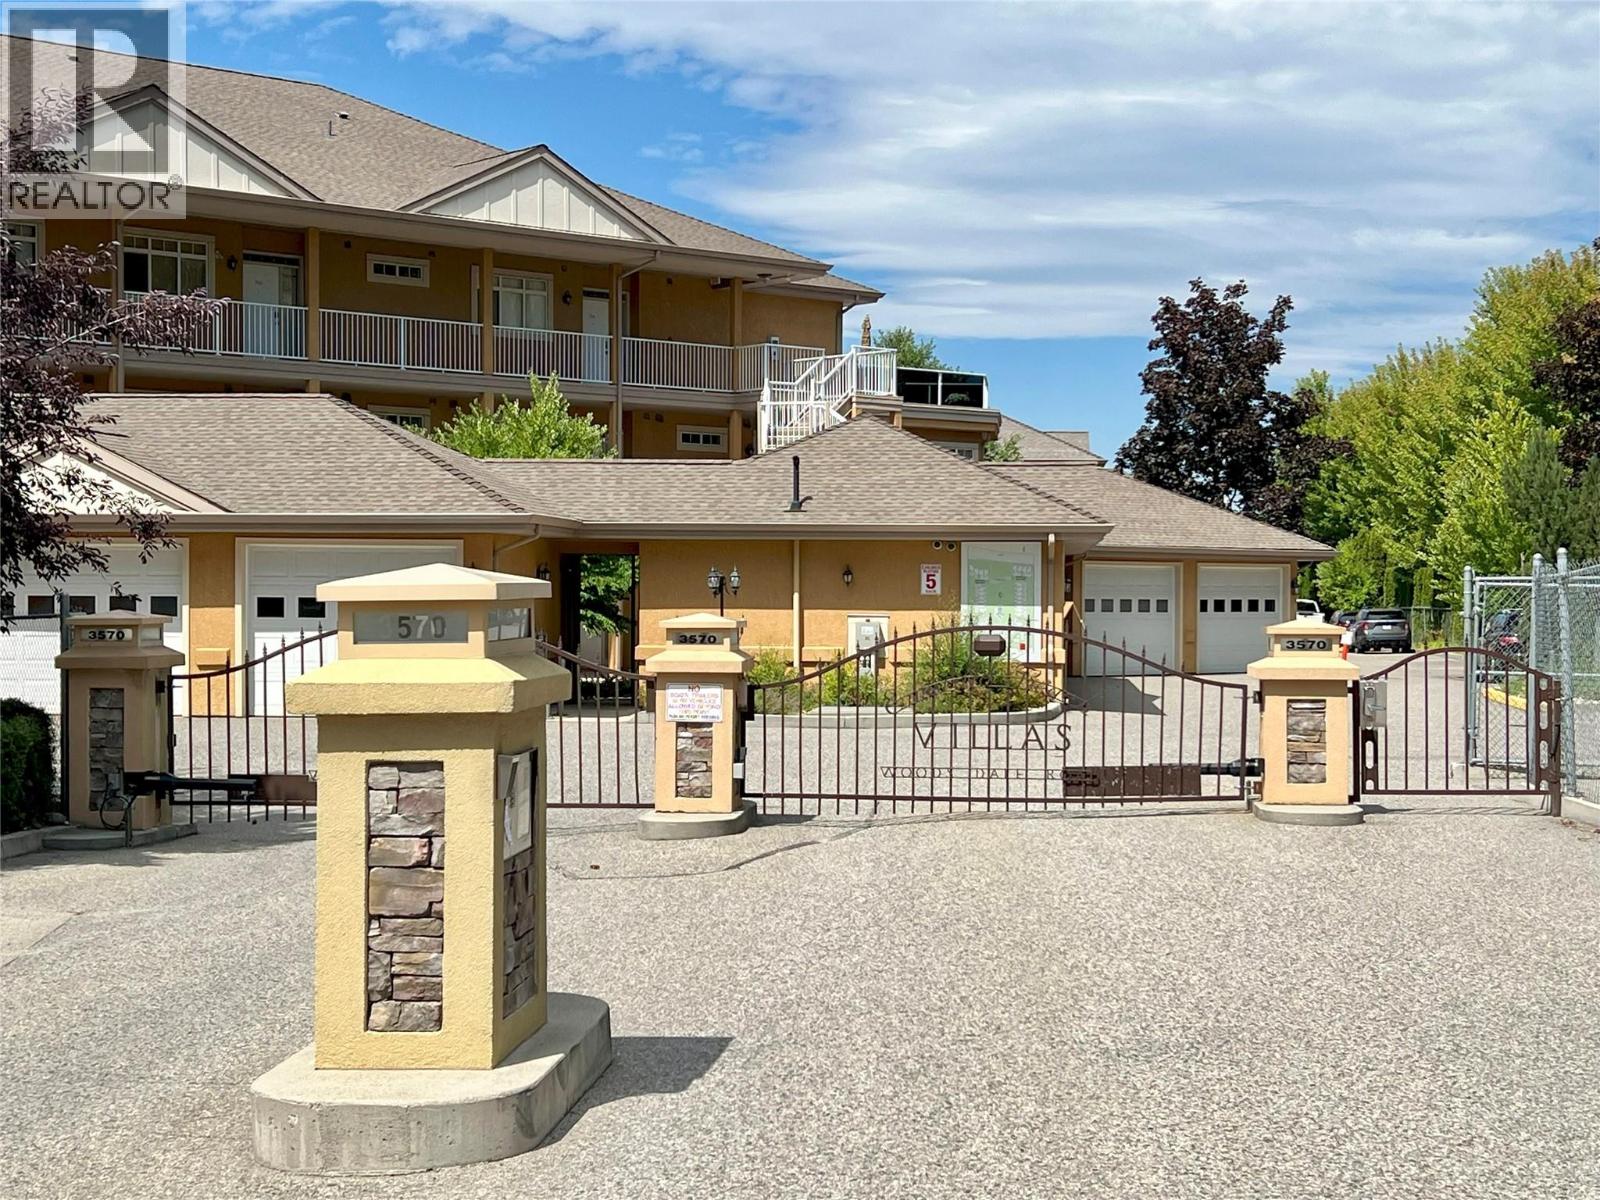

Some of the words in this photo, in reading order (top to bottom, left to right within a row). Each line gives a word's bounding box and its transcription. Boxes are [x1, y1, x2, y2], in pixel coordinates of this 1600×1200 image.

[925, 573, 937, 590] 5
[88, 630, 125, 640] 3570
[679, 634, 717, 644] 3570
[1285, 640, 1327, 650] 3570
[688, 684, 701, 693] NO
[914, 722, 1072, 751] VILLAS
